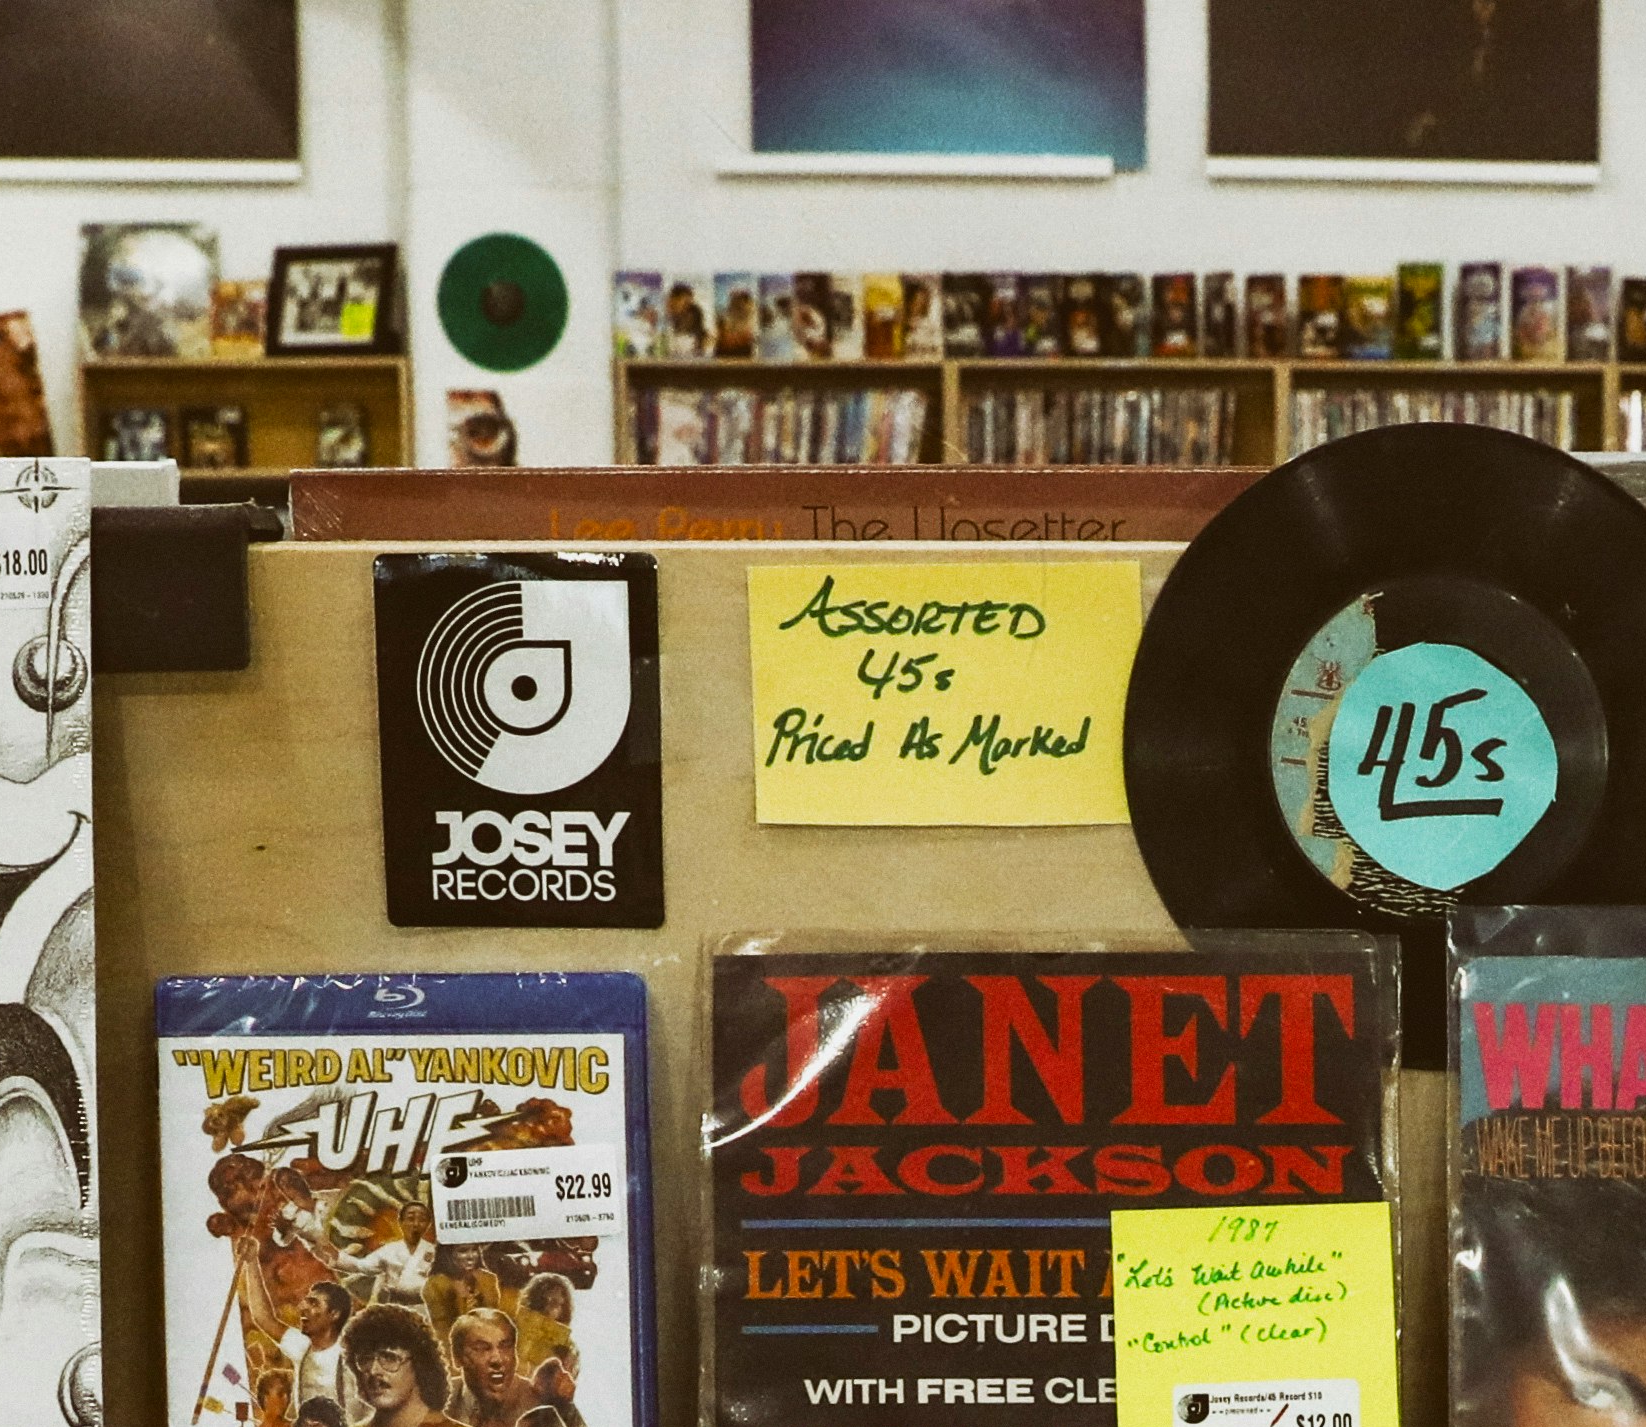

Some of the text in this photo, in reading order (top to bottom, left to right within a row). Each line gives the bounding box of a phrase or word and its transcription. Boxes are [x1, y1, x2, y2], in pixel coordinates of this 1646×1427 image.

[778, 576, 1048, 640] ASSORTED
[858, 649, 956, 700] 45s
[765, 710, 874, 770] Priced
[900, 716, 940, 761] As
[1357, 688, 1509, 807] 45s
[431, 810, 631, 868] JOSEY
[431, 870, 617, 903] RECORDS
[408, 1046, 610, 1094] YANKOVIC
[740, 973, 1356, 1126] JANET
[311, 1088, 495, 1176] UHF
[555, 1173, 611, 1202] $22.99
[740, 1144, 1355, 1197] JACKSON
[1208, 1215, 1278, 1243] 1987
[742, 1248, 1085, 1300] LET'S WAIT
[892, 1314, 1087, 1344] PICTURE
[803, 1378, 1035, 1404] WITH FREE
